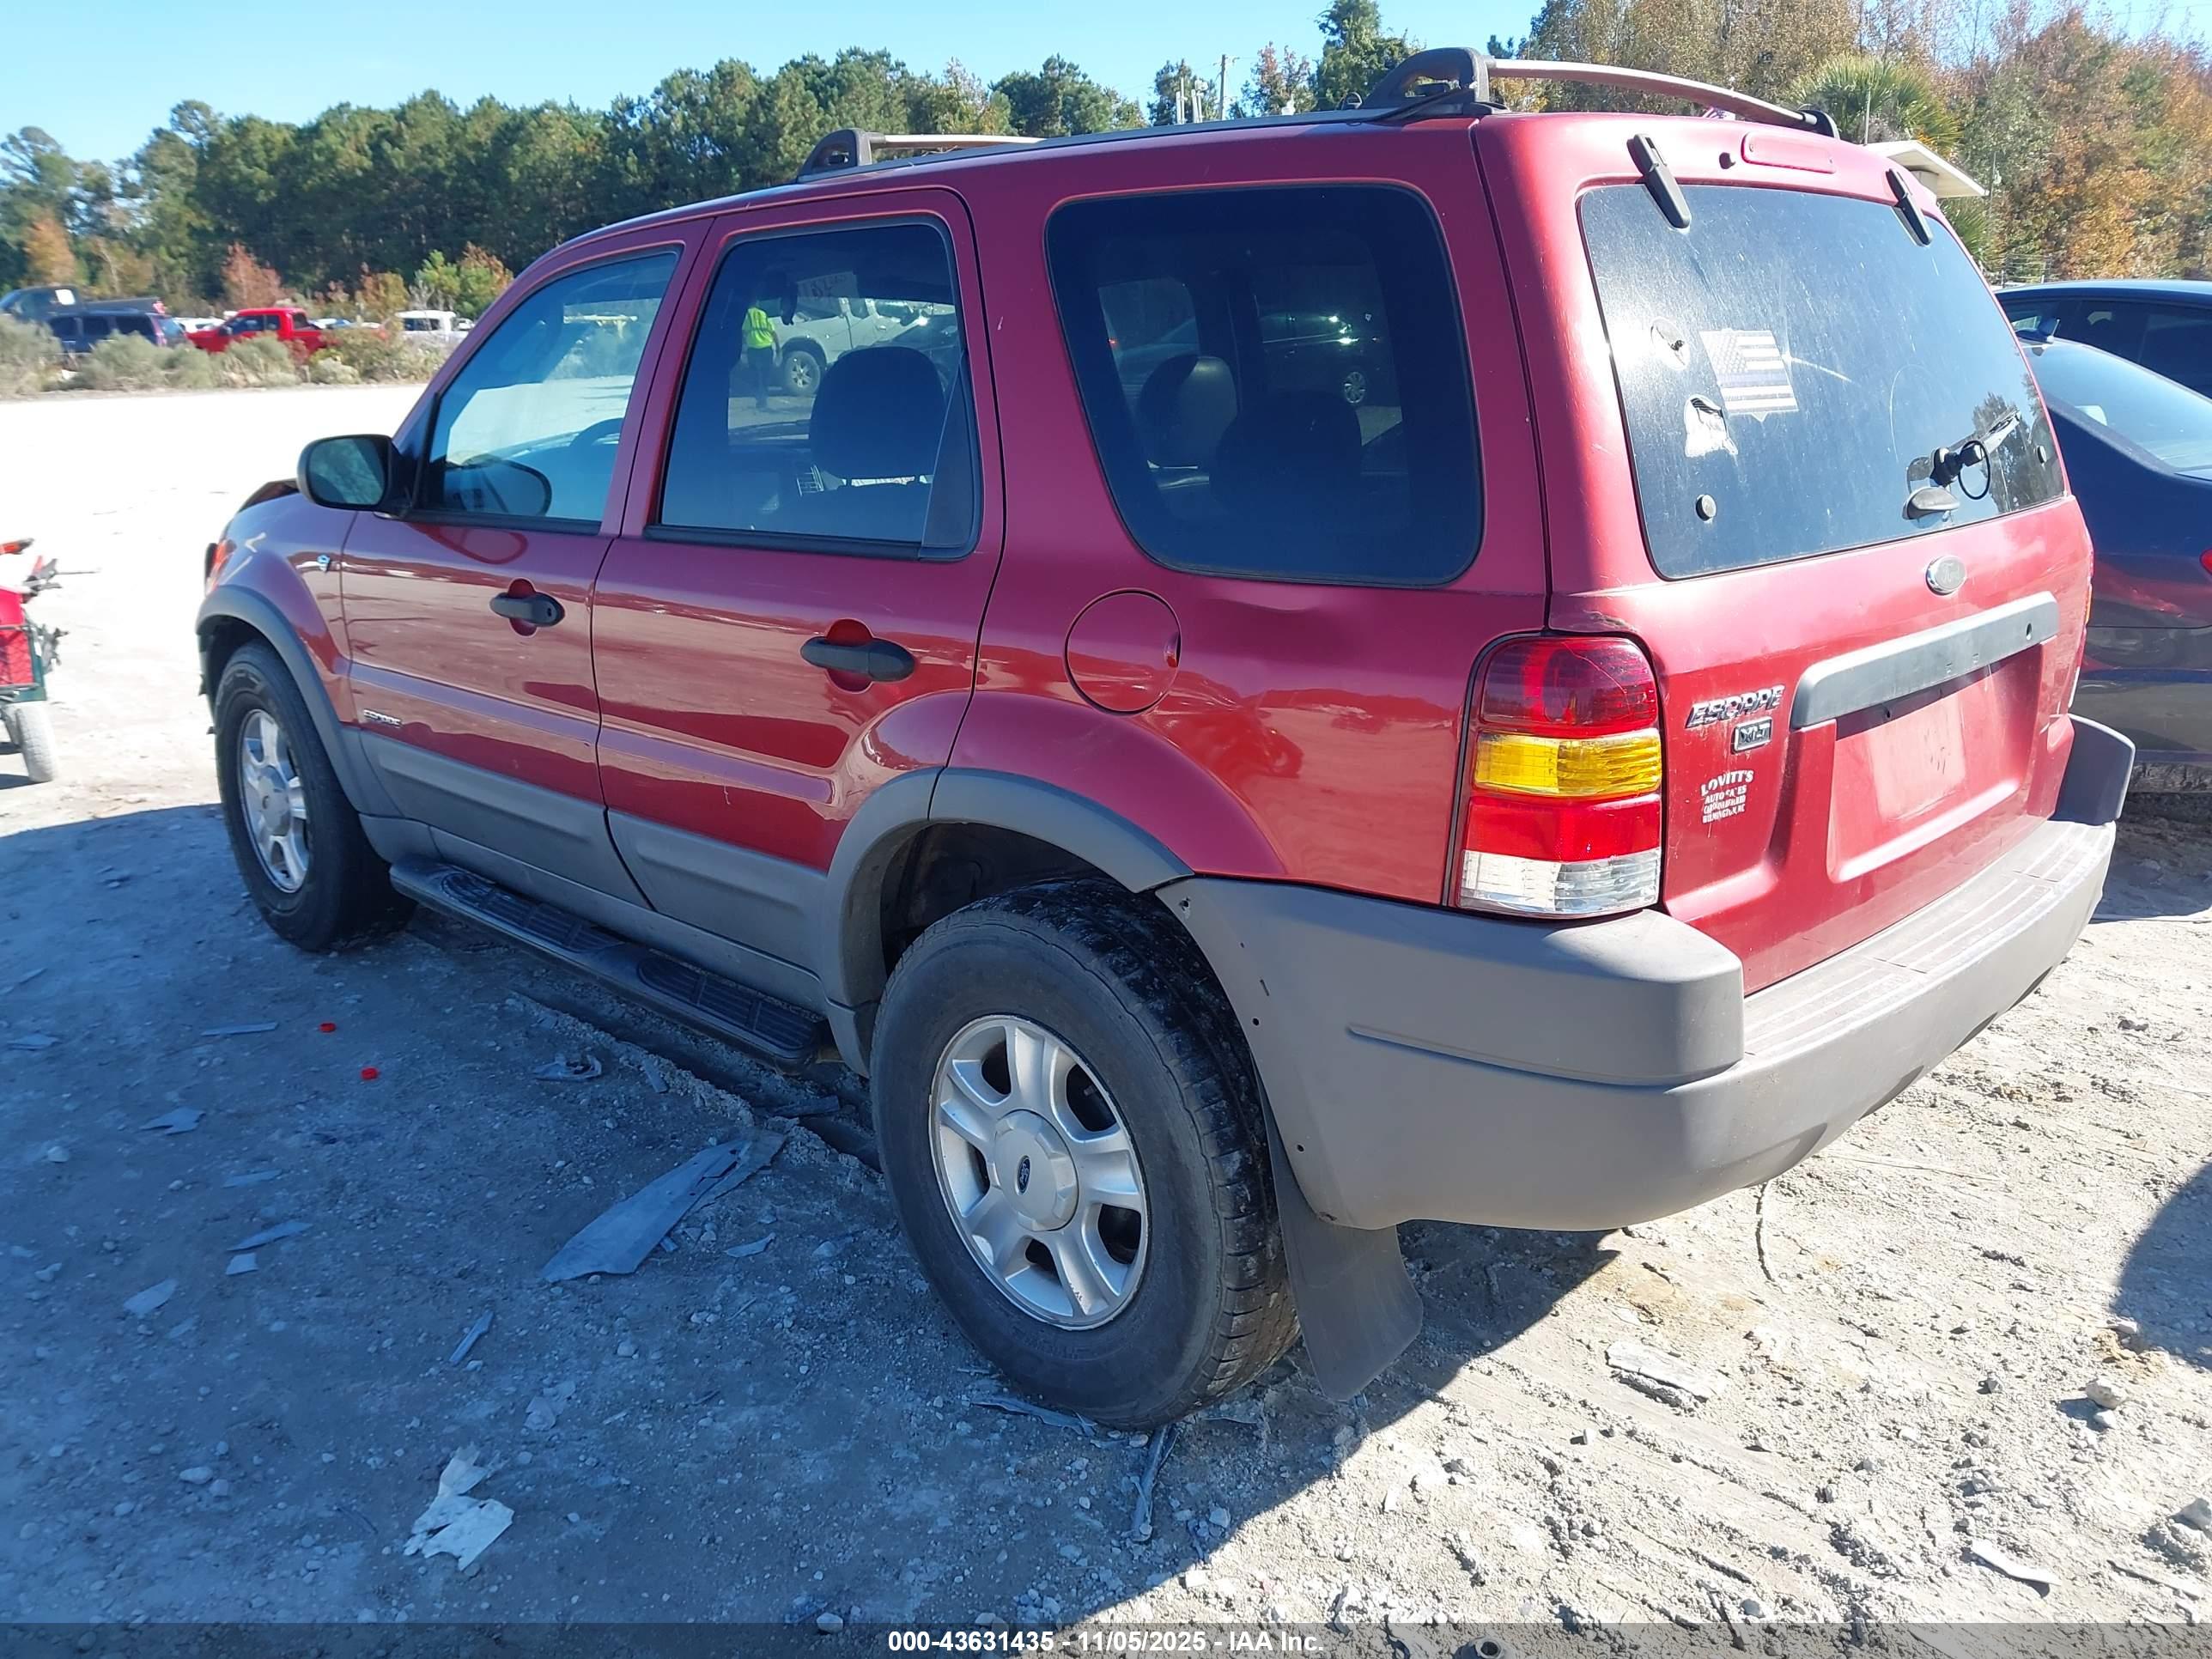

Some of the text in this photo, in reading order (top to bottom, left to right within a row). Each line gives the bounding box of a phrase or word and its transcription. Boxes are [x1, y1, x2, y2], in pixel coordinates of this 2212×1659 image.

[1684, 684, 1785, 729] ESCAPE
[1740, 722, 1770, 744] XLT
[1701, 769, 1754, 797] LOVITT'S
[1705, 792, 1725, 805] AUTO
